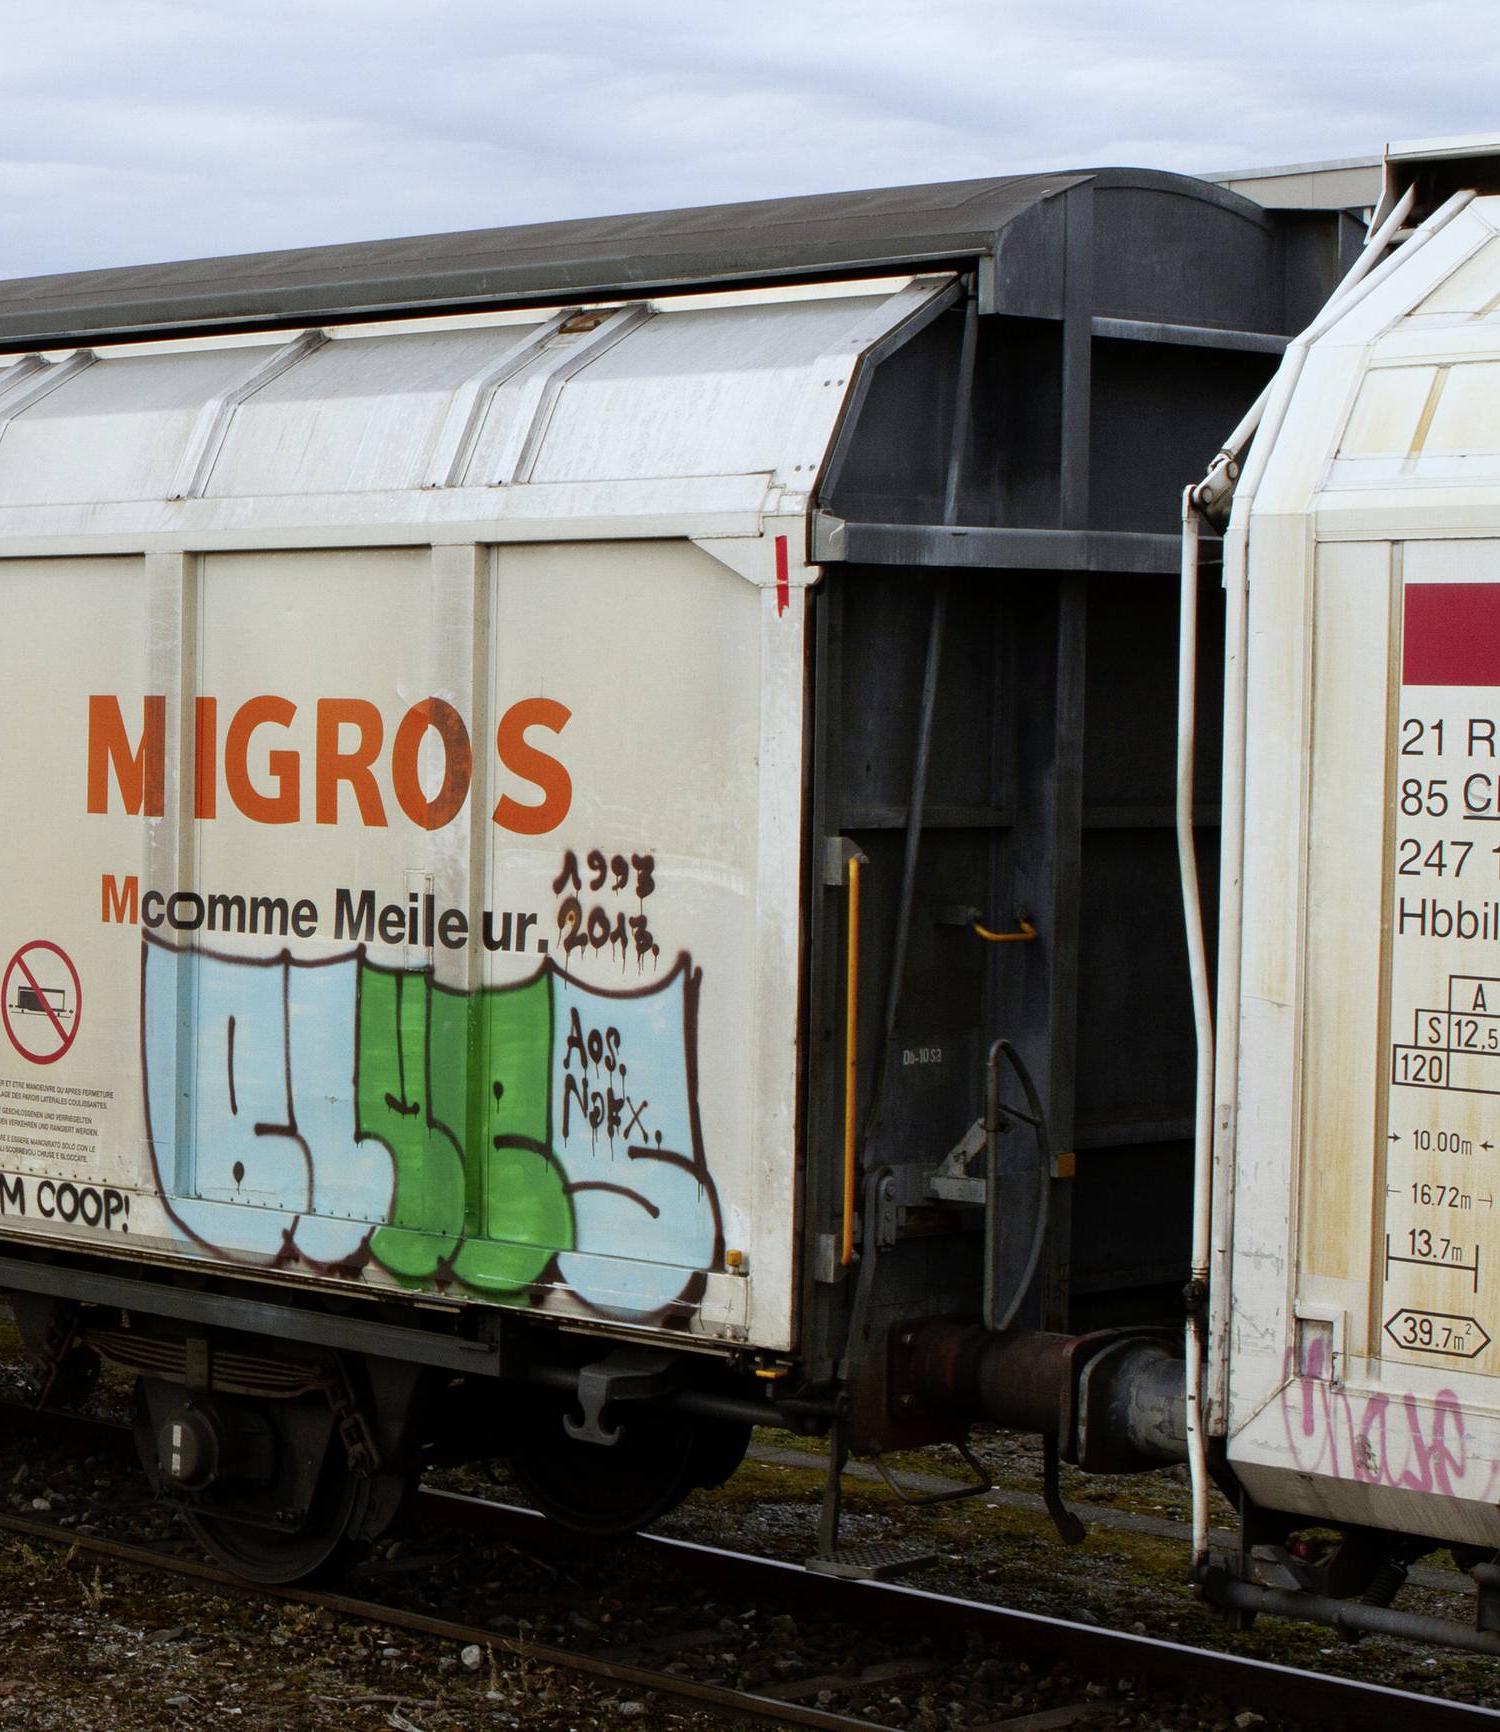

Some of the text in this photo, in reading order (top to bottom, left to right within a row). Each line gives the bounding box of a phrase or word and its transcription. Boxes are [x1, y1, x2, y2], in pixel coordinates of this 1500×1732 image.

[1401, 718, 1443, 756] 21
[87, 694, 573, 835] MIGROS
[1400, 772, 1500, 821] 85 C
[1398, 837, 1474, 878] 247
[1471, 983, 1488, 1012] A
[1428, 1016, 1442, 1044] S
[1401, 1053, 1443, 1084] 120
[1412, 1129, 1472, 1155] 10.00m
[37, 1180, 130, 1234] COOP!
[1411, 1182, 1471, 1209] 16.72m
[1408, 1228, 1463, 1261] 13.7m
